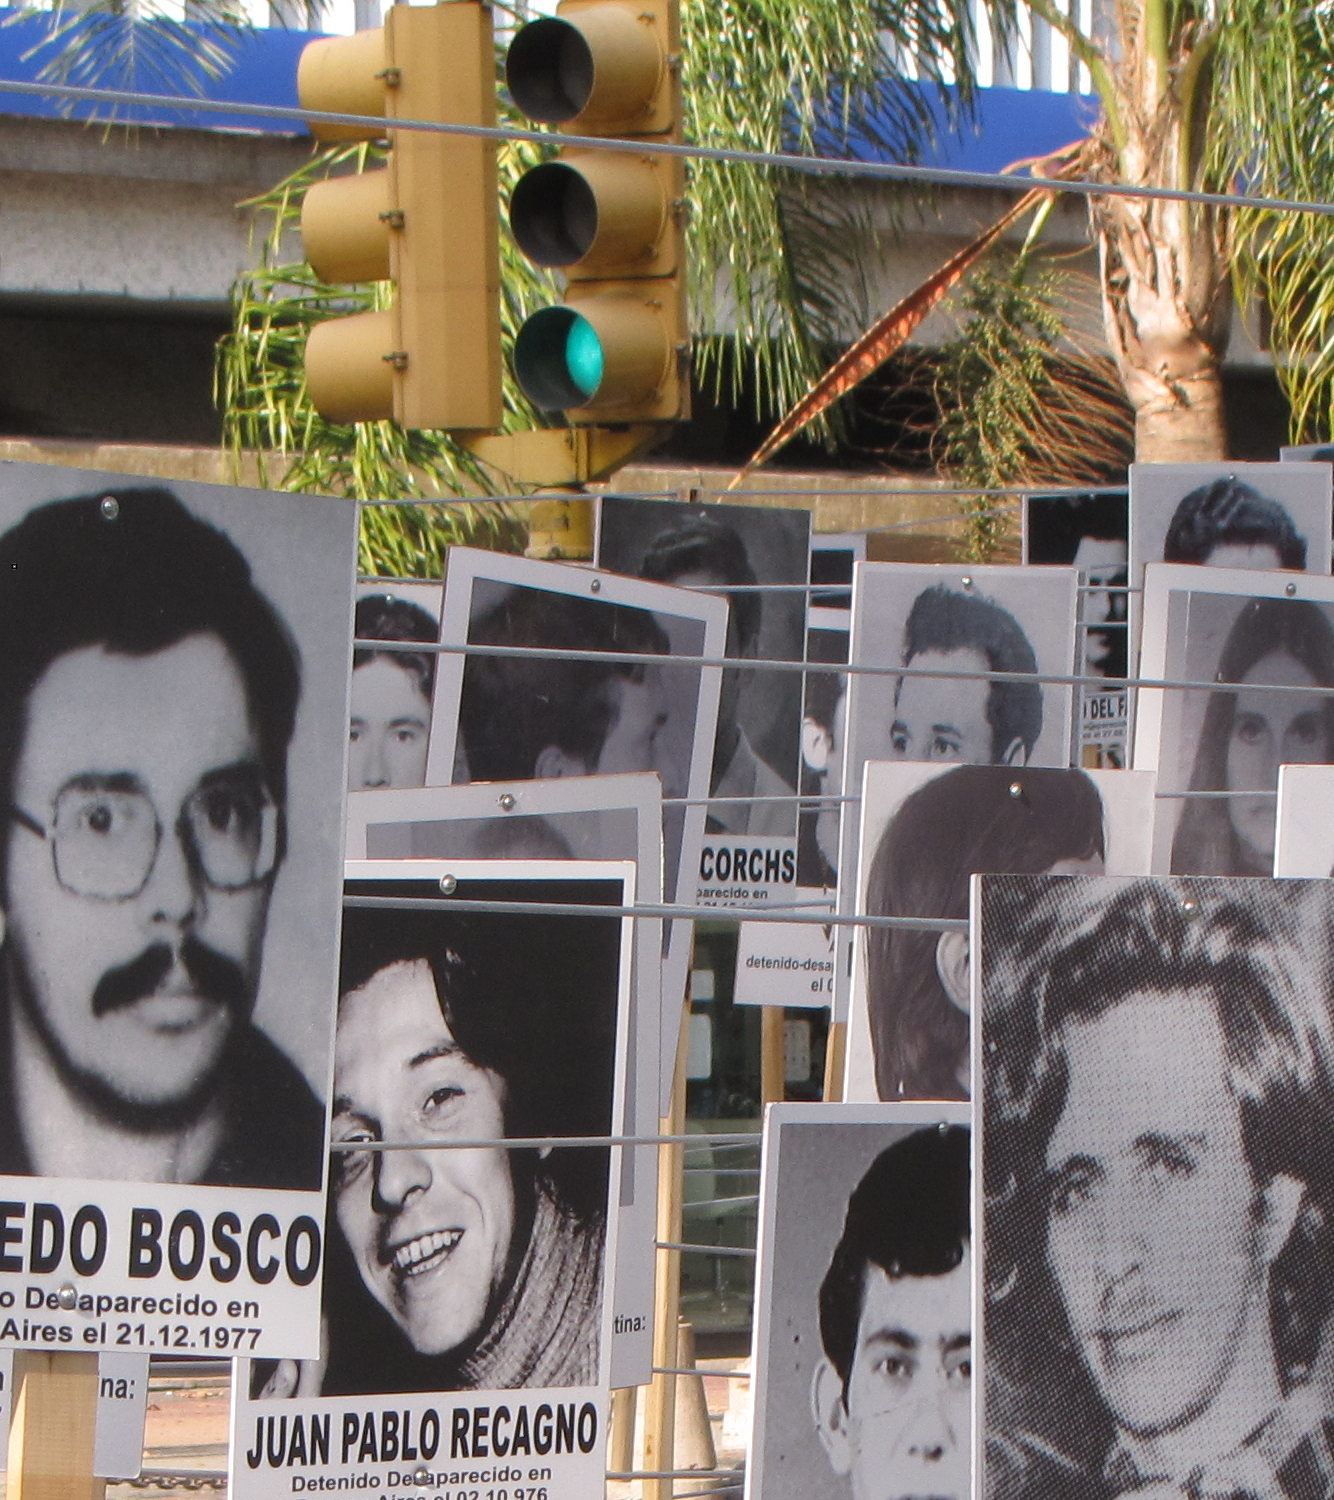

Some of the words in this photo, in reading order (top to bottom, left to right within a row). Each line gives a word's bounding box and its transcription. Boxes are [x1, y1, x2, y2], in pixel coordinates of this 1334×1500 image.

[700, 847, 795, 883] CORCHS
[753, 889, 768, 899] en
[746, 955, 834, 972] detenido-desa
[128, 1207, 321, 1286] BOSCO
[25, 1286, 218, 1319] Deaparecido
[227, 1298, 259, 1319] en
[0, 1317, 73, 1344] Aires
[82, 1322, 107, 1346] el
[116, 1323, 262, 1350] 21.12.1977
[246, 1413, 330, 1469] JUAN
[341, 1408, 441, 1464] PABLO
[450, 1401, 598, 1459] RECAGNO
[291, 1472, 381, 1494] Detenido
[528, 1467, 552, 1482] en
